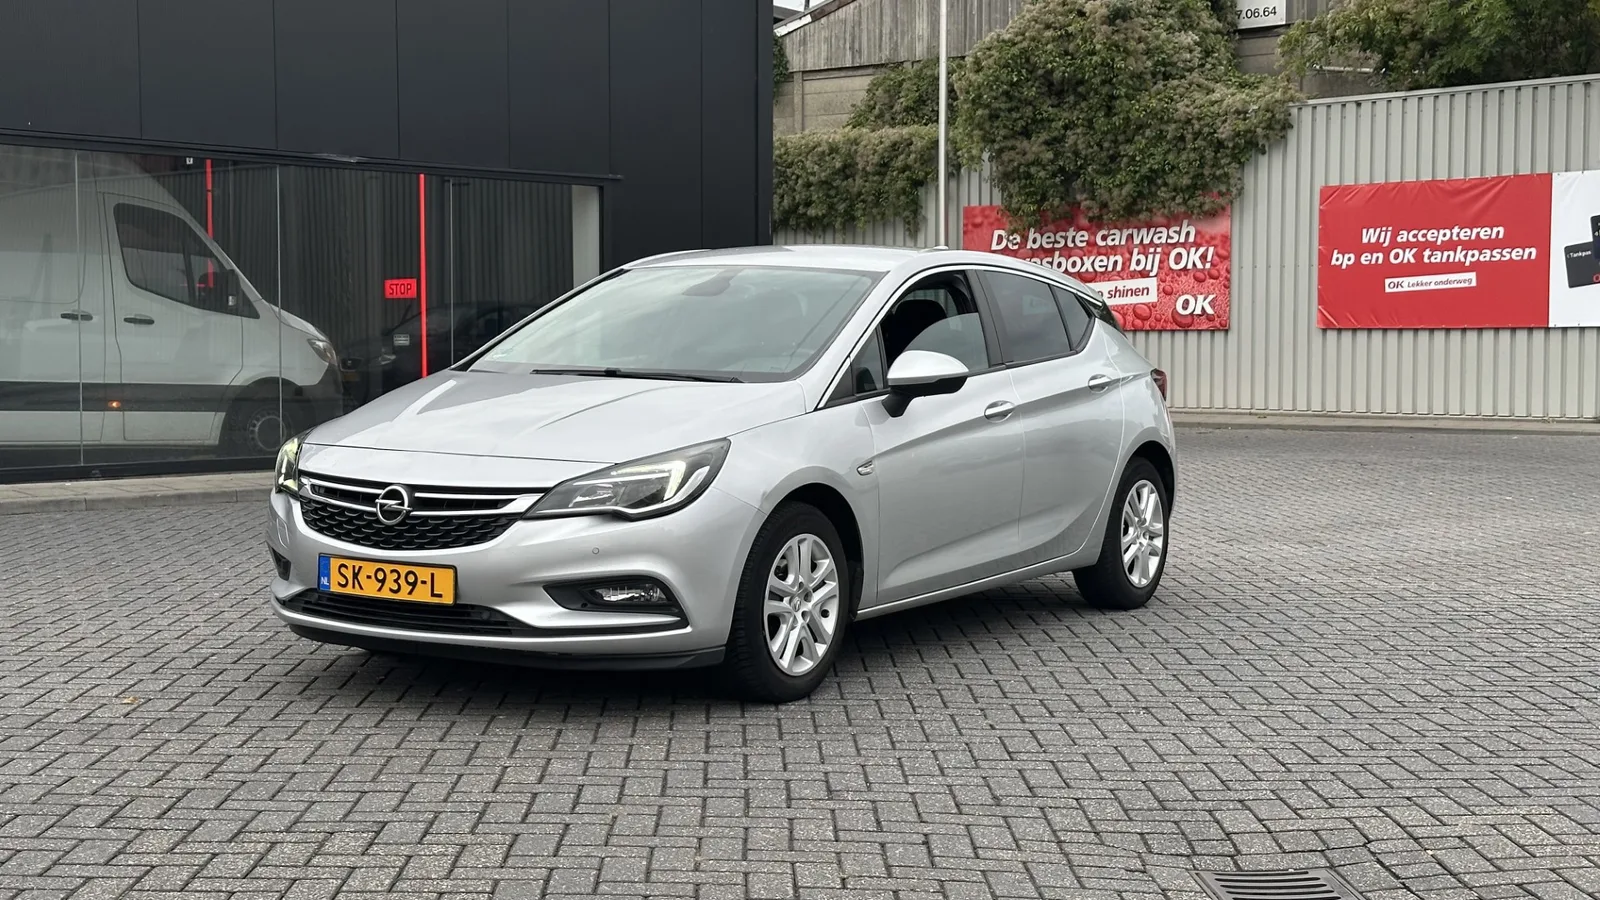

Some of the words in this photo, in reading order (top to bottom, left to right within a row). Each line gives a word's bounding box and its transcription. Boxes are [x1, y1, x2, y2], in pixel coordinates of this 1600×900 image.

[991, 229, 1021, 250] De
[1027, 227, 1089, 249] beste
[1095, 219, 1196, 247] carwash
[1361, 227, 1392, 247] Wij
[1396, 225, 1504, 245] accepteren
[1129, 247, 1160, 276] bij
[1168, 246, 1215, 271] OK!
[1331, 250, 1355, 269] bp
[1360, 251, 1384, 265] en
[1389, 247, 1418, 264] OK
[1423, 245, 1537, 267] tankpassen
[388, 283, 412, 295] STOP
[1107, 286, 1150, 299] shinen
[1388, 280, 1405, 289] OK
[1407, 279, 1432, 288] Lekker
[1434, 278, 1473, 286] onderweg
[1175, 294, 1215, 315] OK
[320, 577, 329, 585] NL
[337, 563, 443, 598] SK-939-L
